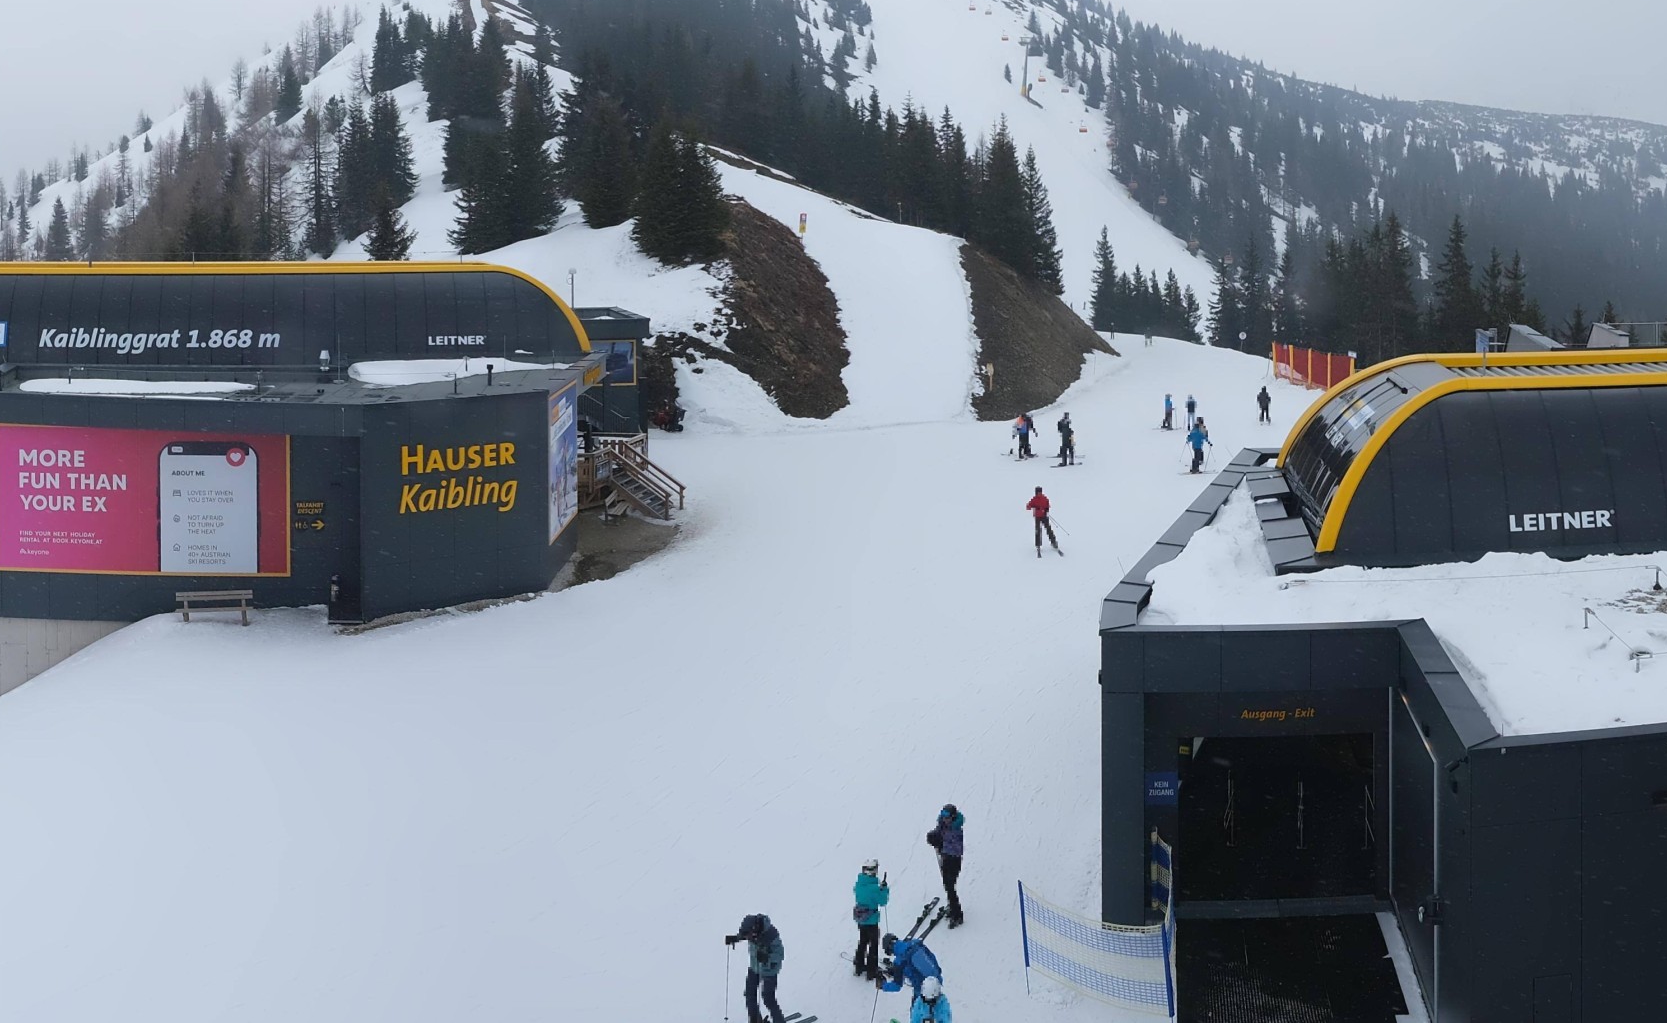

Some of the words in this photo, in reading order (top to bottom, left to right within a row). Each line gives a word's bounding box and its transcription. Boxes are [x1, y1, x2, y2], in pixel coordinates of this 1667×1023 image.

[38, 327, 181, 354] Kaiblinggrat
[186, 329, 252, 348] 1.868
[258, 333, 280, 348] m
[428, 336, 485, 346] LEITNER
[18, 448, 86, 468] MORE
[401, 442, 516, 476] HAUSER
[18, 472, 60, 489] FUN
[66, 474, 127, 490] THAN
[20, 494, 76, 512] YOUR
[82, 496, 107, 512] EX
[399, 476, 518, 514] Kaibling
[1508, 510, 1612, 532] LEITNER
[1240, 710, 1286, 721] Ausgang
[1294, 708, 1316, 718] Exit
